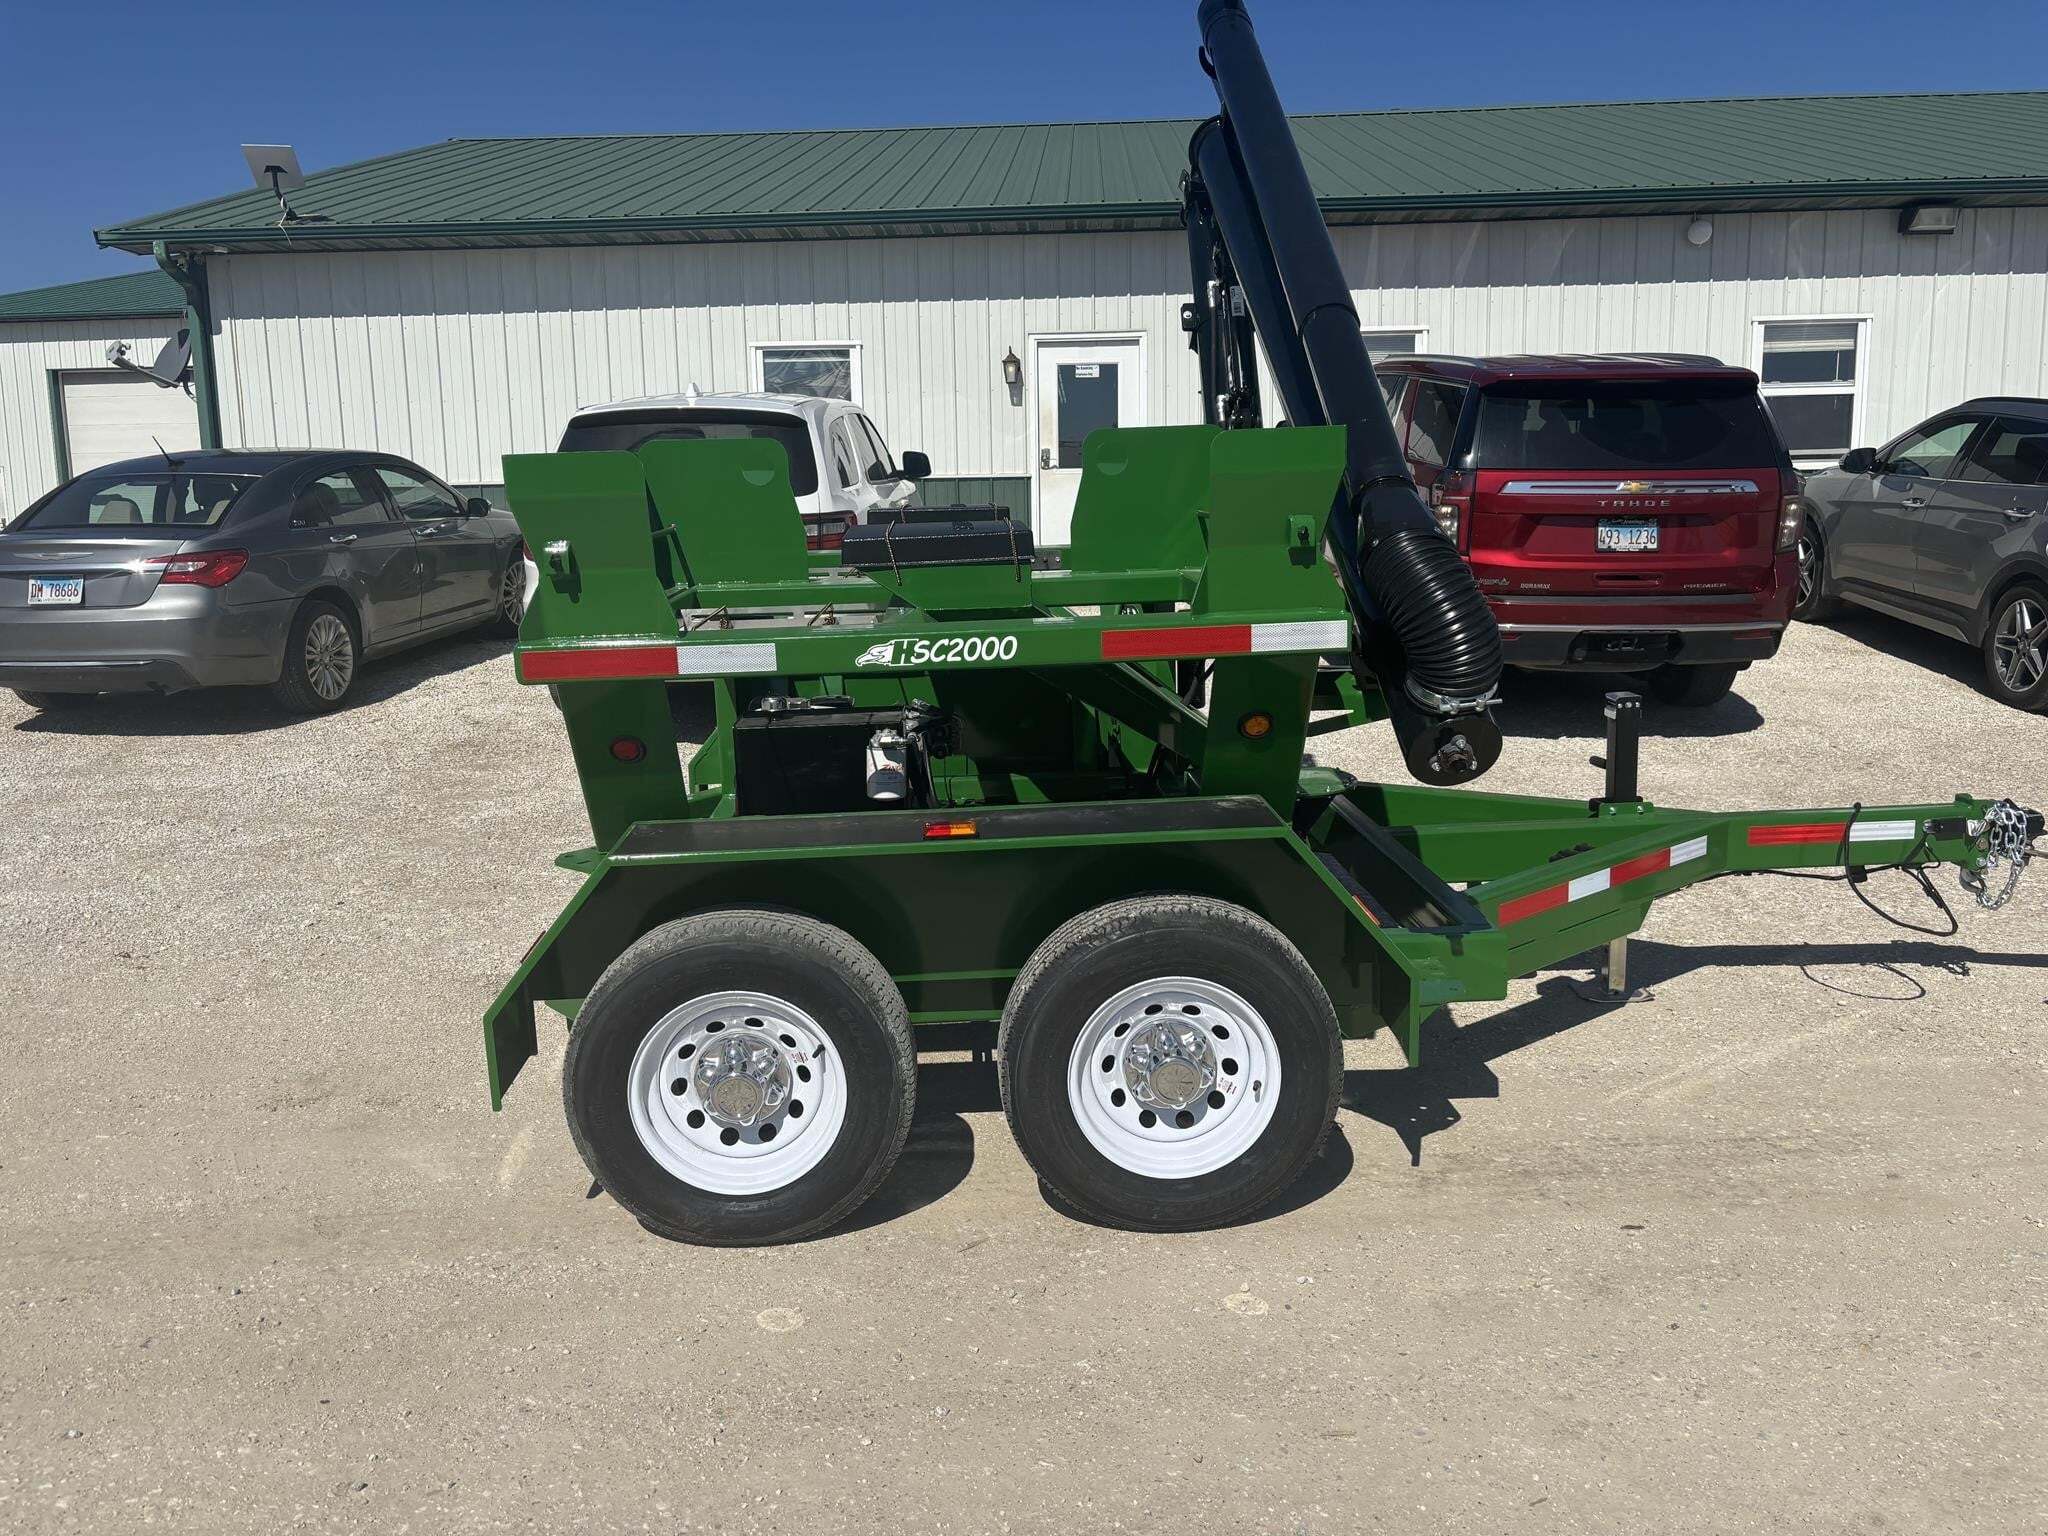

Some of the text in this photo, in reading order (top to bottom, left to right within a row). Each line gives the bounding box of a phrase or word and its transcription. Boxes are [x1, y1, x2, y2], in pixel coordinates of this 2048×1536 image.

[1597, 499, 1671, 508] TAHOE
[1600, 529, 1656, 545] 493 1236
[49, 583, 79, 598] 78686
